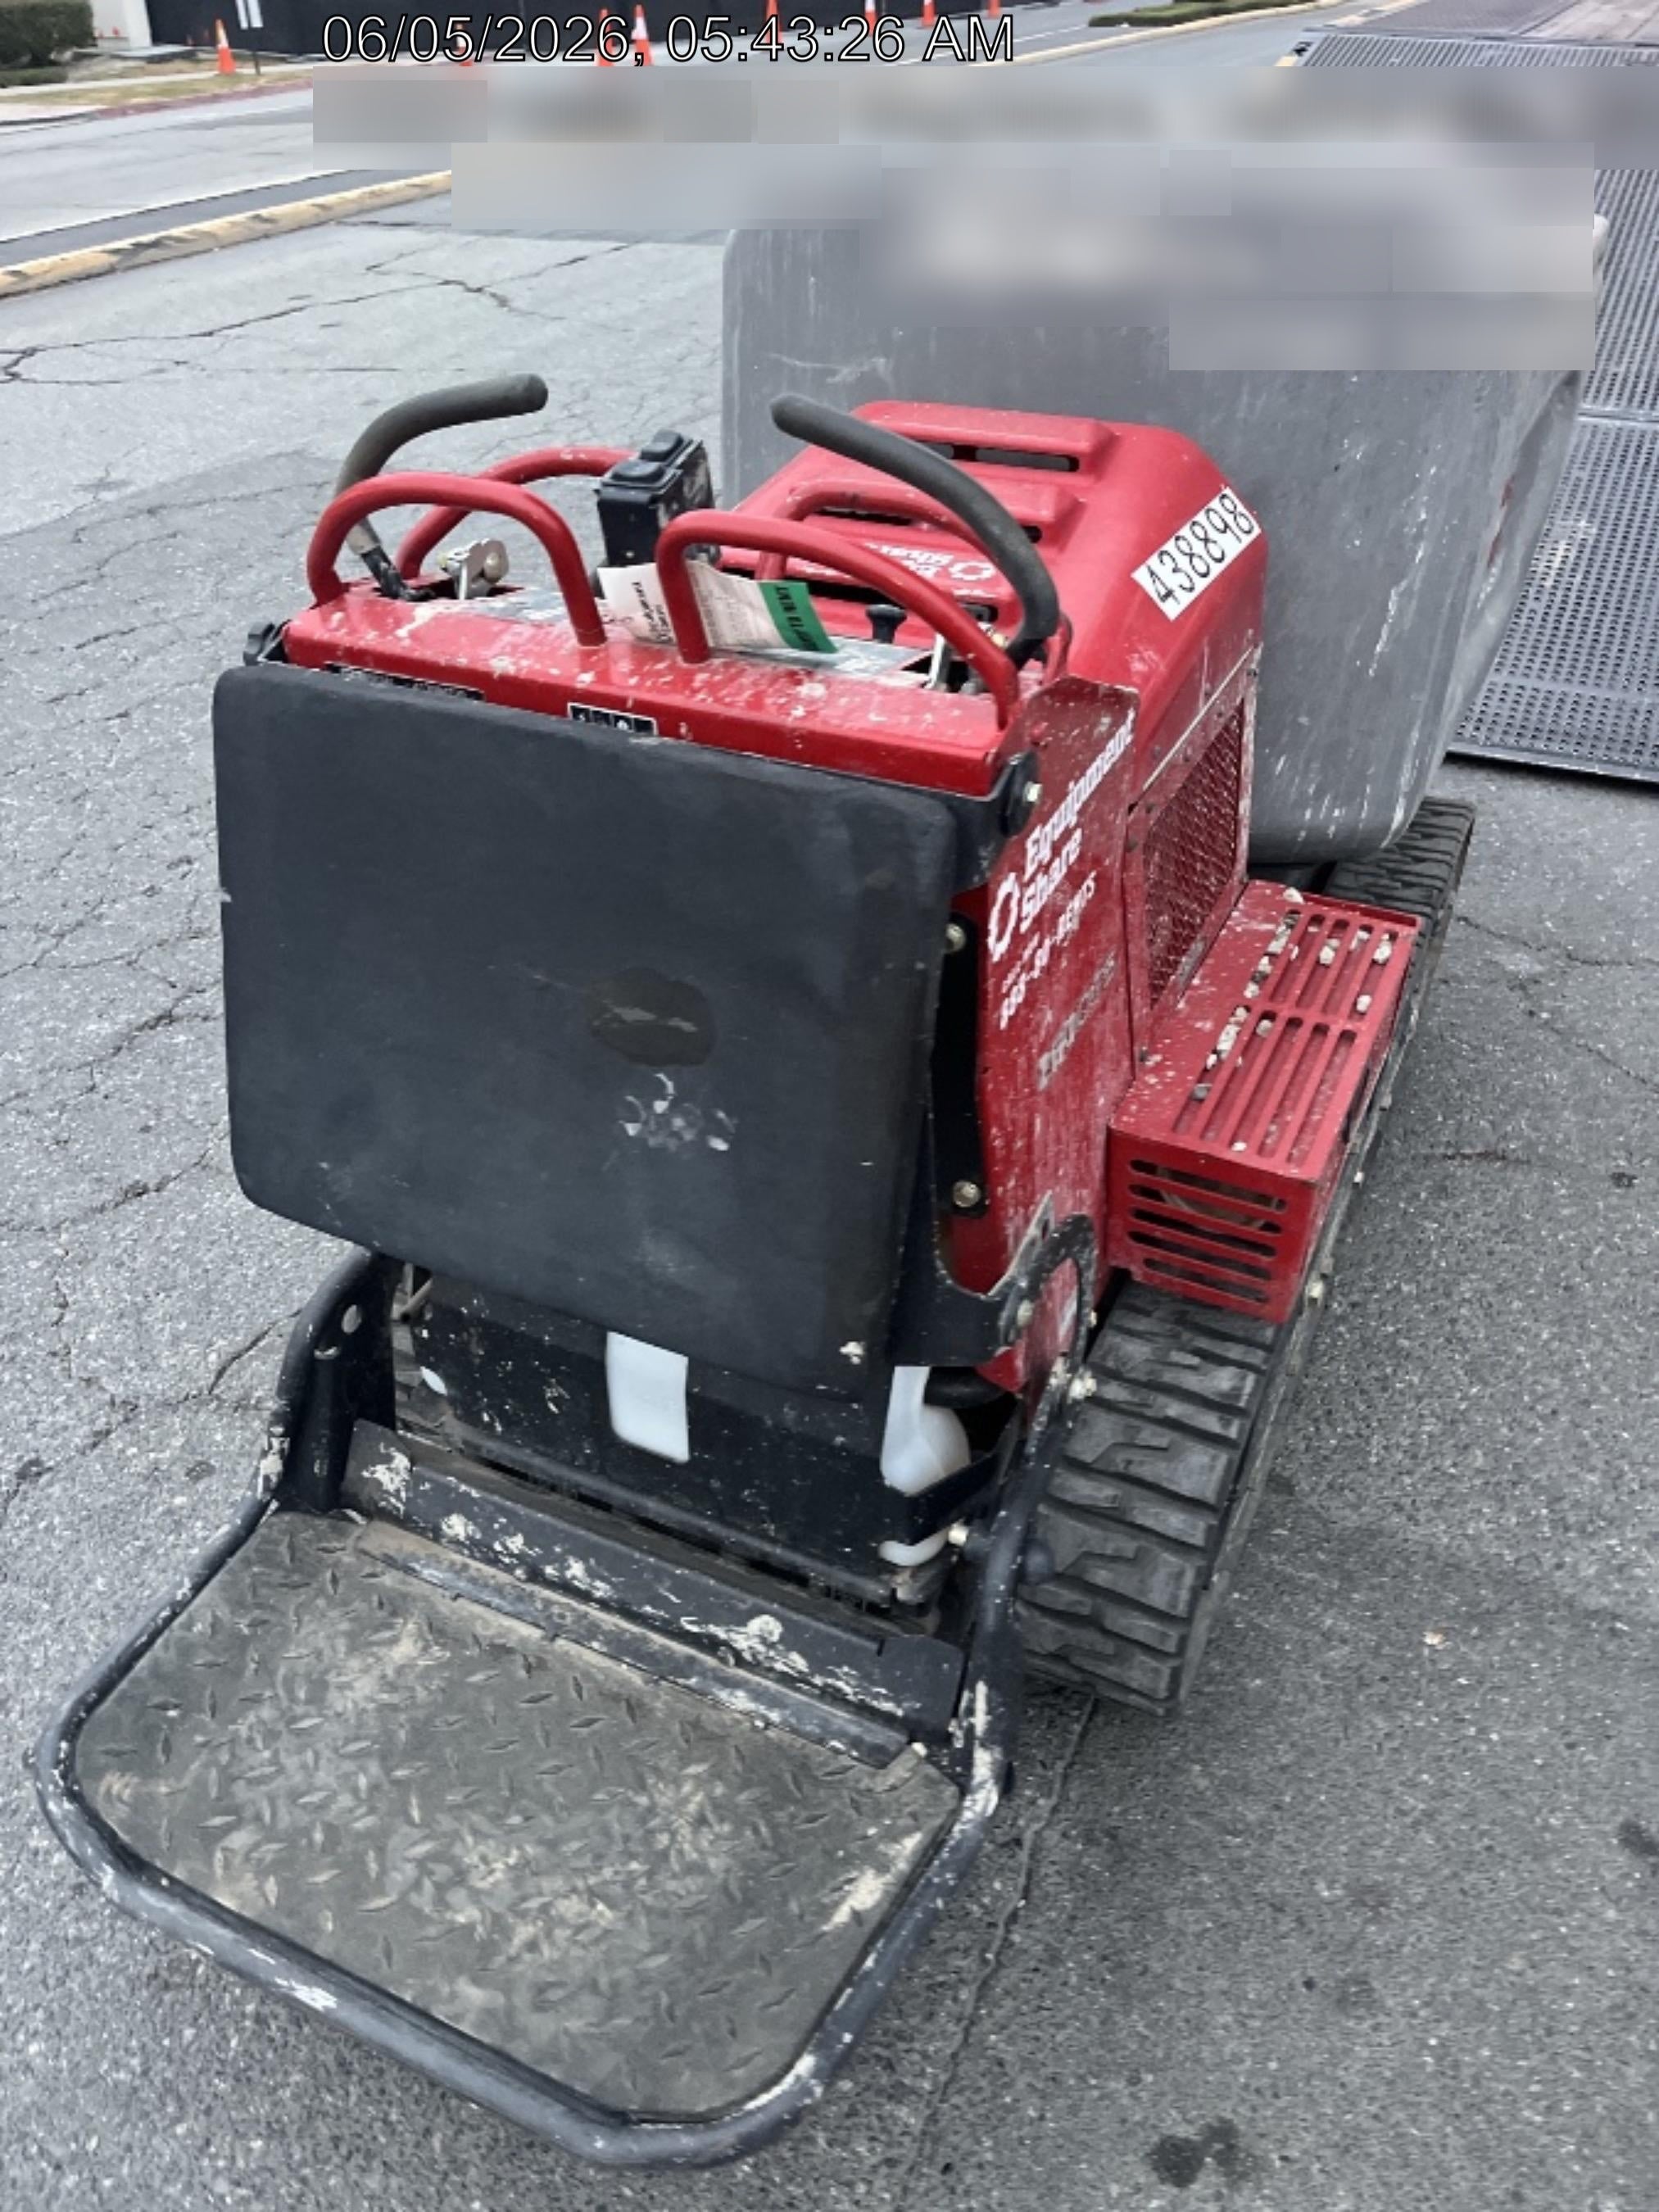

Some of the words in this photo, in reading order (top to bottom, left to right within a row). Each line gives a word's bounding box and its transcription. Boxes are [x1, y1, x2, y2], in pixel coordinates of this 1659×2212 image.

[1146, 494, 1254, 605] 438898
[1023, 707, 1135, 882] Equipment
[1020, 827, 1082, 933] Share
